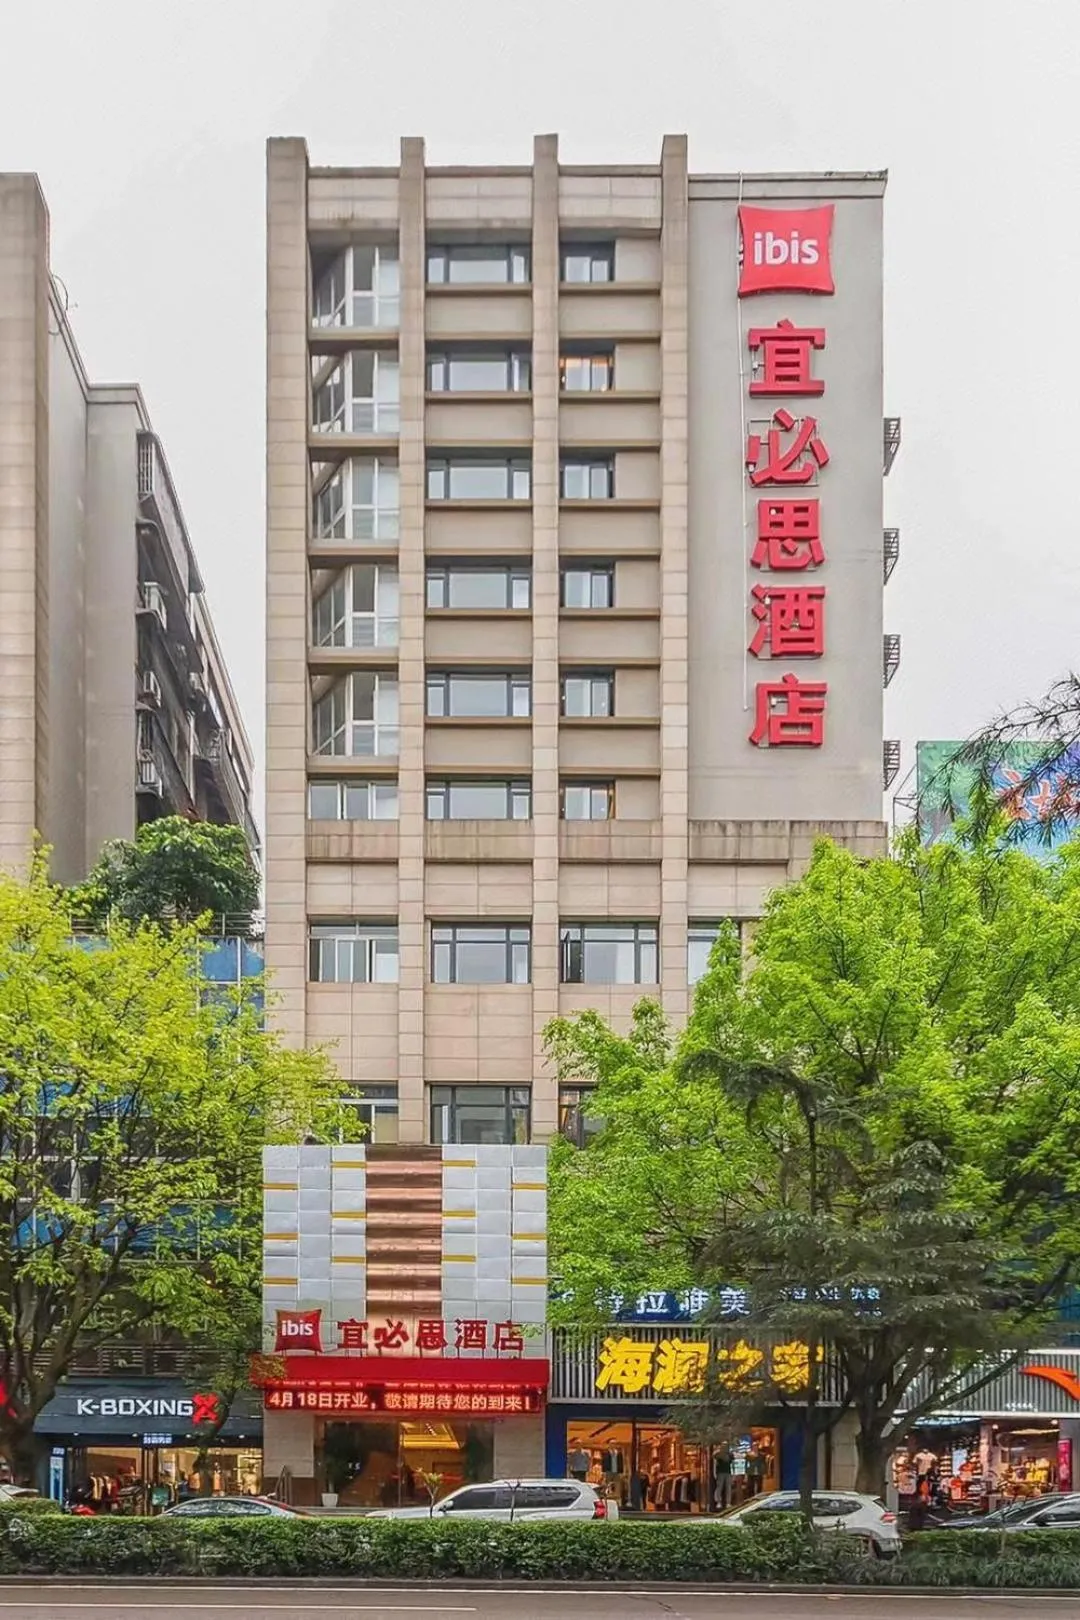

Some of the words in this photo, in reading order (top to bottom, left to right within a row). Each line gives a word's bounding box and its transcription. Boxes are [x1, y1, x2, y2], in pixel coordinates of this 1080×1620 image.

[754, 231, 819, 265] ibis
[746, 318, 830, 748] 宜必思酒店
[281, 1320, 314, 1336] ibis
[337, 1318, 524, 1351] 宜必思酒店
[77, 1398, 194, 1416] K-BOXING
